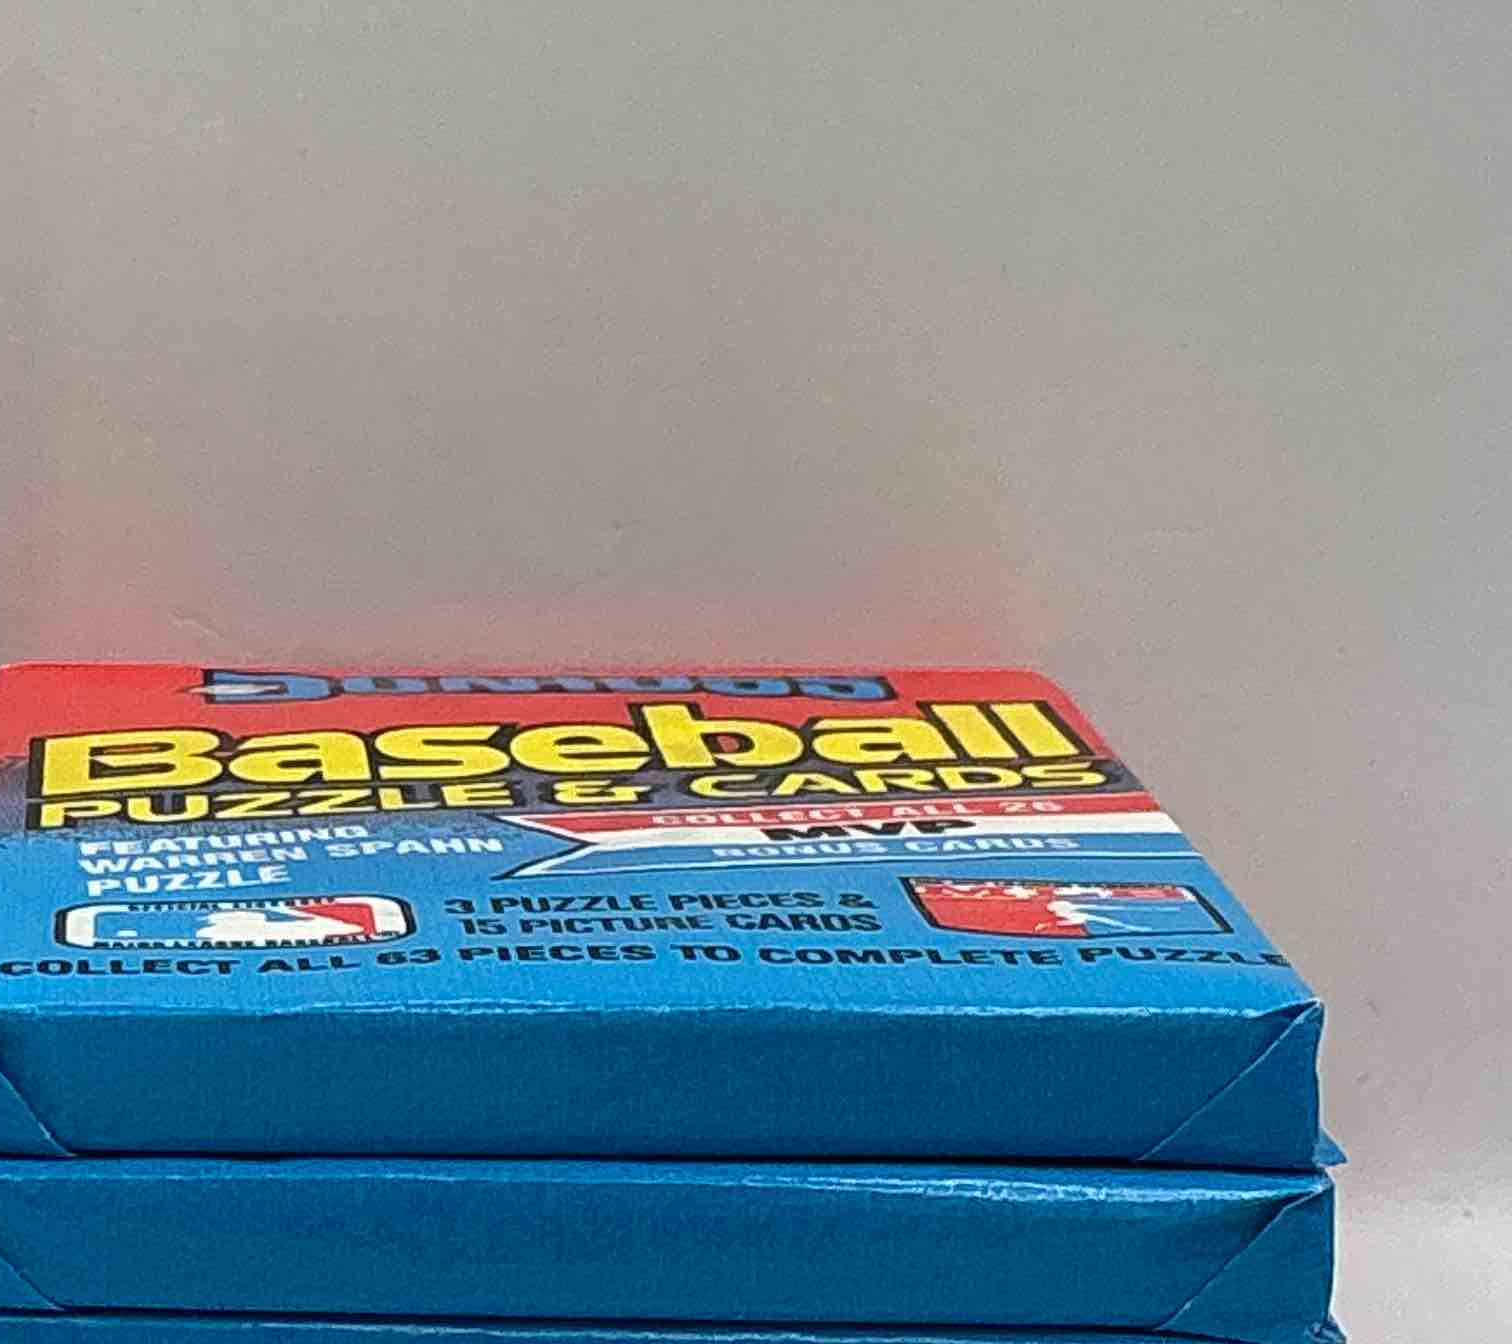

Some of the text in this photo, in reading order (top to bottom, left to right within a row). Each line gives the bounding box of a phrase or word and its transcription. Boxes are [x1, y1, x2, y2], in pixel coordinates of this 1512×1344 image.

[26, 699, 1095, 801] Baseball
[25, 761, 1110, 830] PUZZLE & CARDS
[890, 802, 983, 818] ALL
[77, 824, 371, 857] FEATURING
[712, 834, 1081, 857] BONUS CARDS
[759, 818, 979, 842] MVP
[77, 834, 504, 875] WARREN SPAHN
[86, 865, 294, 897] PUZZLE
[445, 891, 879, 915] 3 PUZZLE PIECES &
[458, 912, 884, 935] 15 PICTURE CARDS
[257, 954, 362, 974] ALL
[377, 945, 440, 965] 63
[458, 943, 656, 962] PIECES
[672, 943, 742, 963] TO
[759, 944, 1063, 966] COMPLETE
[1077, 946, 1291, 968] PUZZLE
